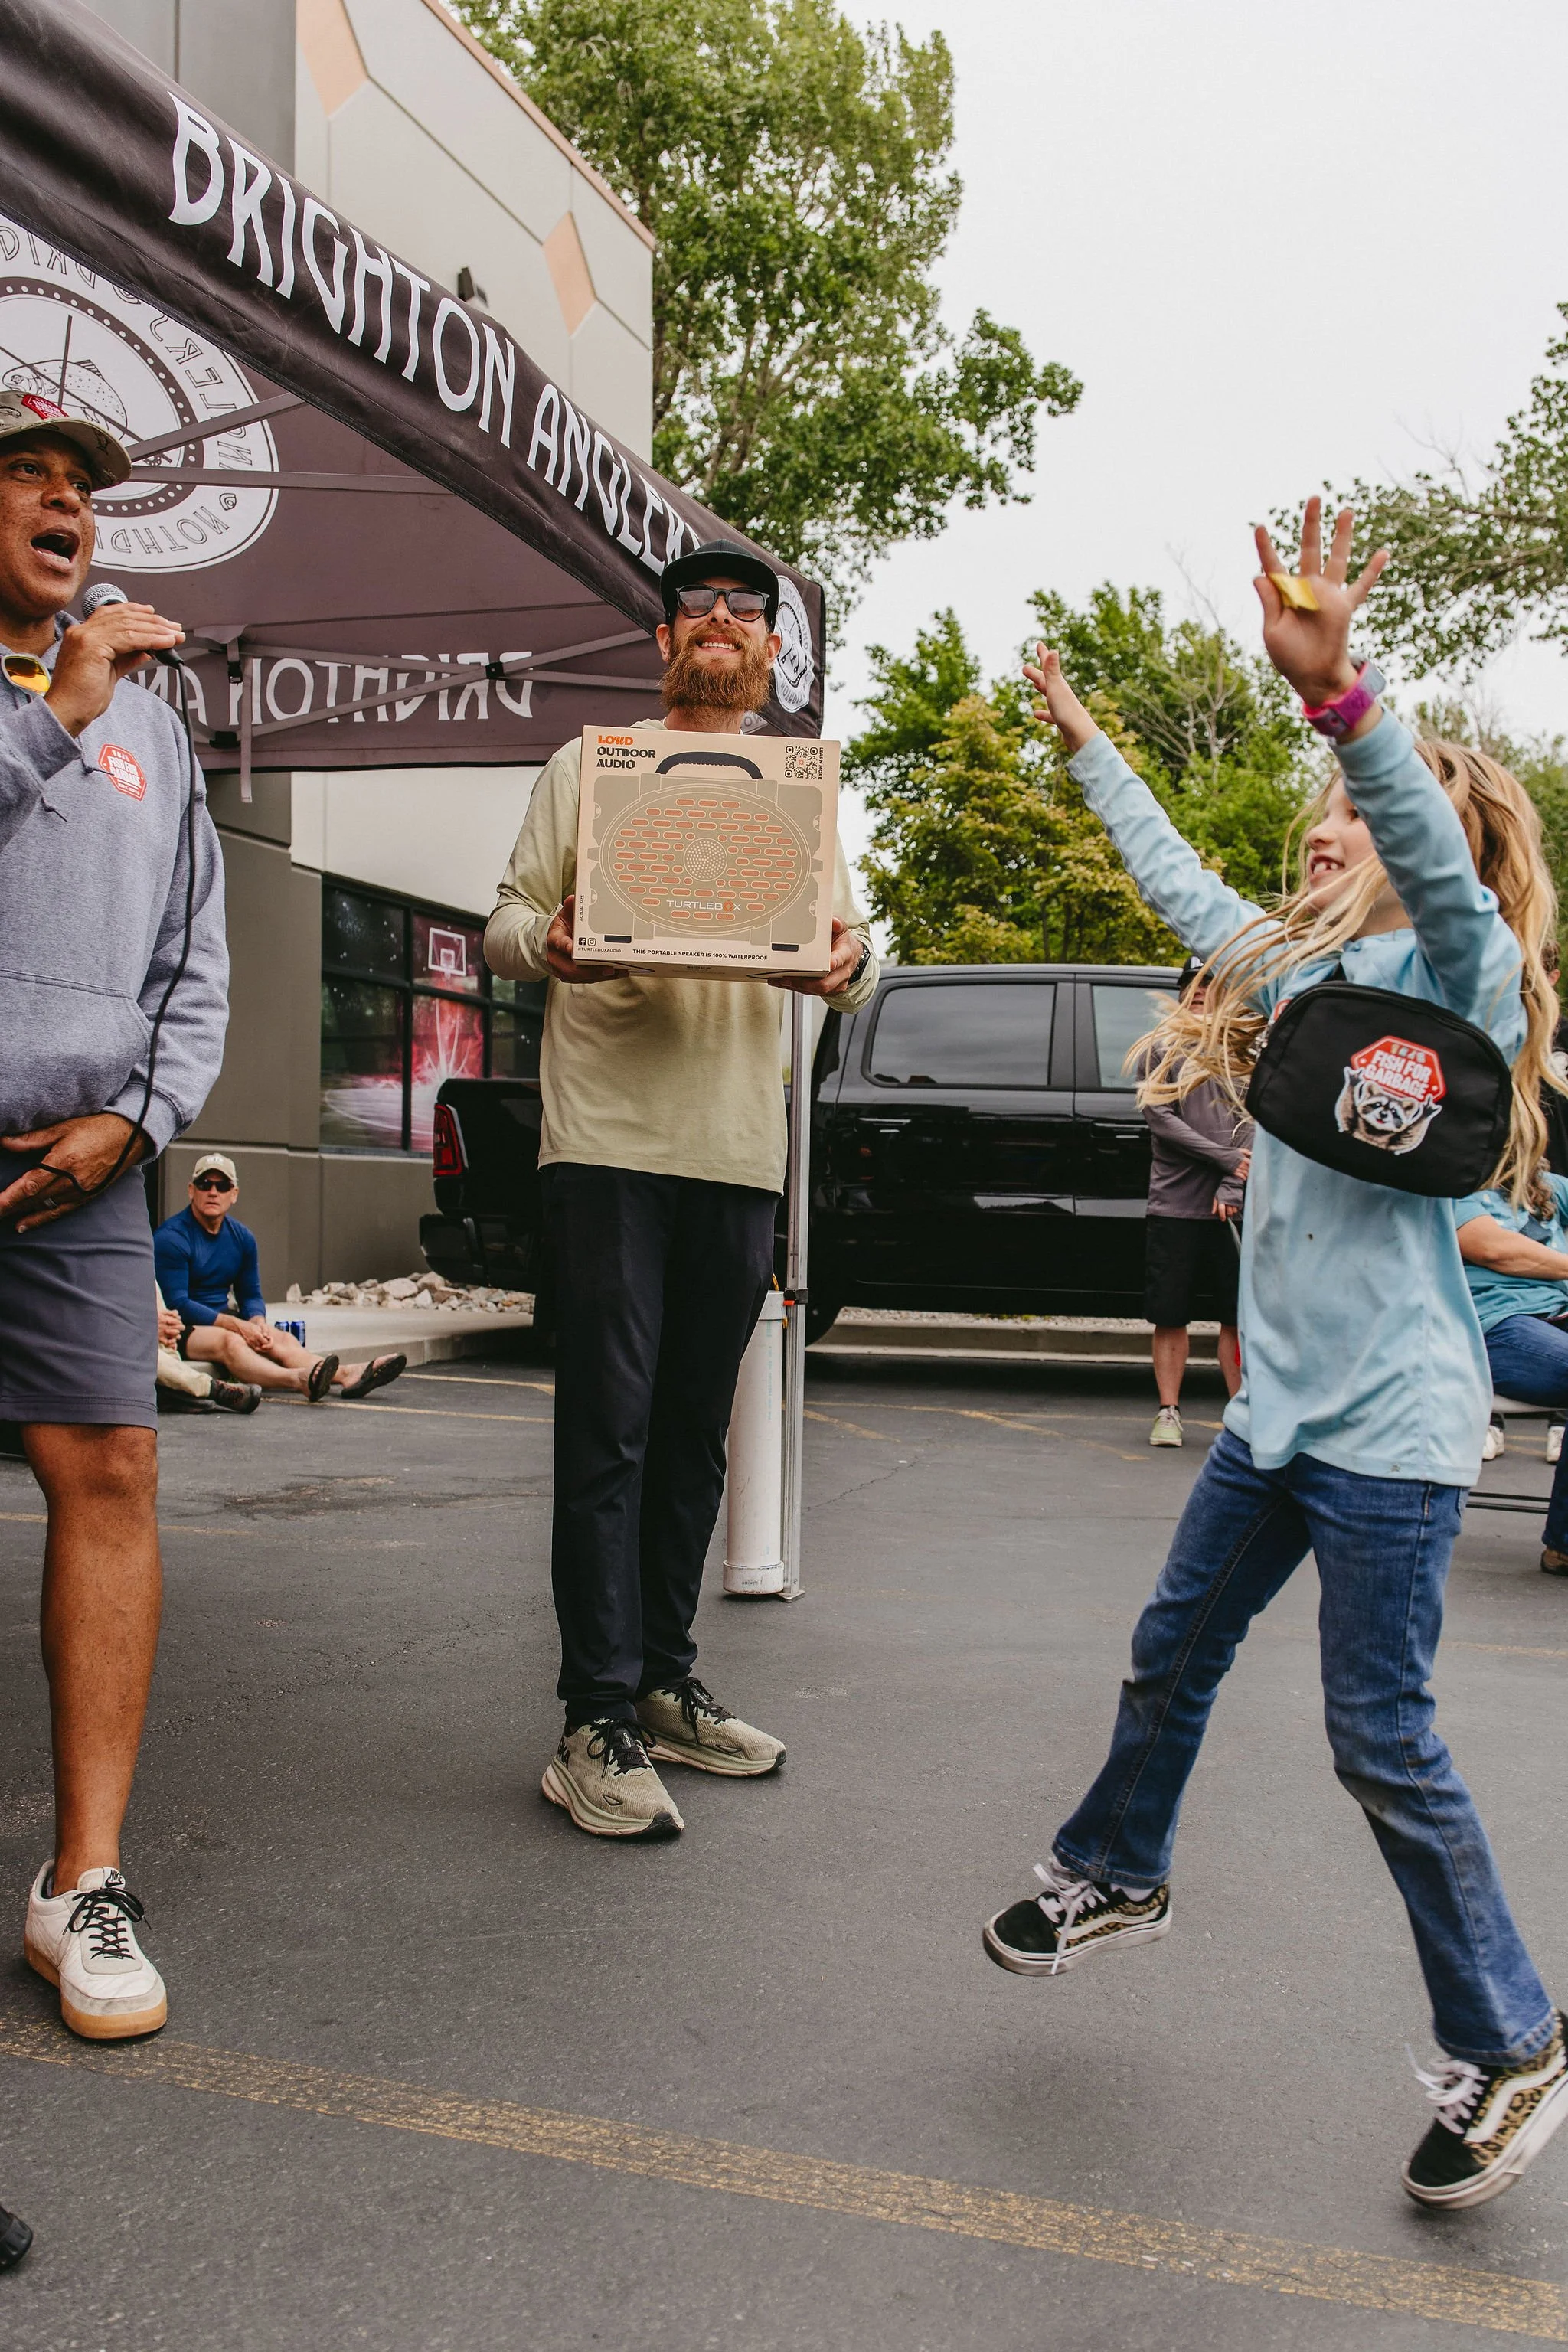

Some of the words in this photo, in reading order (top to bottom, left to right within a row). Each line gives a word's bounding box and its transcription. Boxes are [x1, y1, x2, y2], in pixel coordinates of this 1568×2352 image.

[168, 90, 514, 449] BRIGHTON
[598, 735, 634, 746] LOUD
[597, 746, 656, 758] OUTDOOR
[596, 759, 635, 769] AUDIO
[666, 900, 742, 912] TURTLEBOX
[1371, 1050, 1406, 1073] FISH
[1403, 1060, 1432, 1083] FOR
[1364, 1063, 1430, 1101] GARBAGE
[109, 1869, 123, 1883] NIKE
